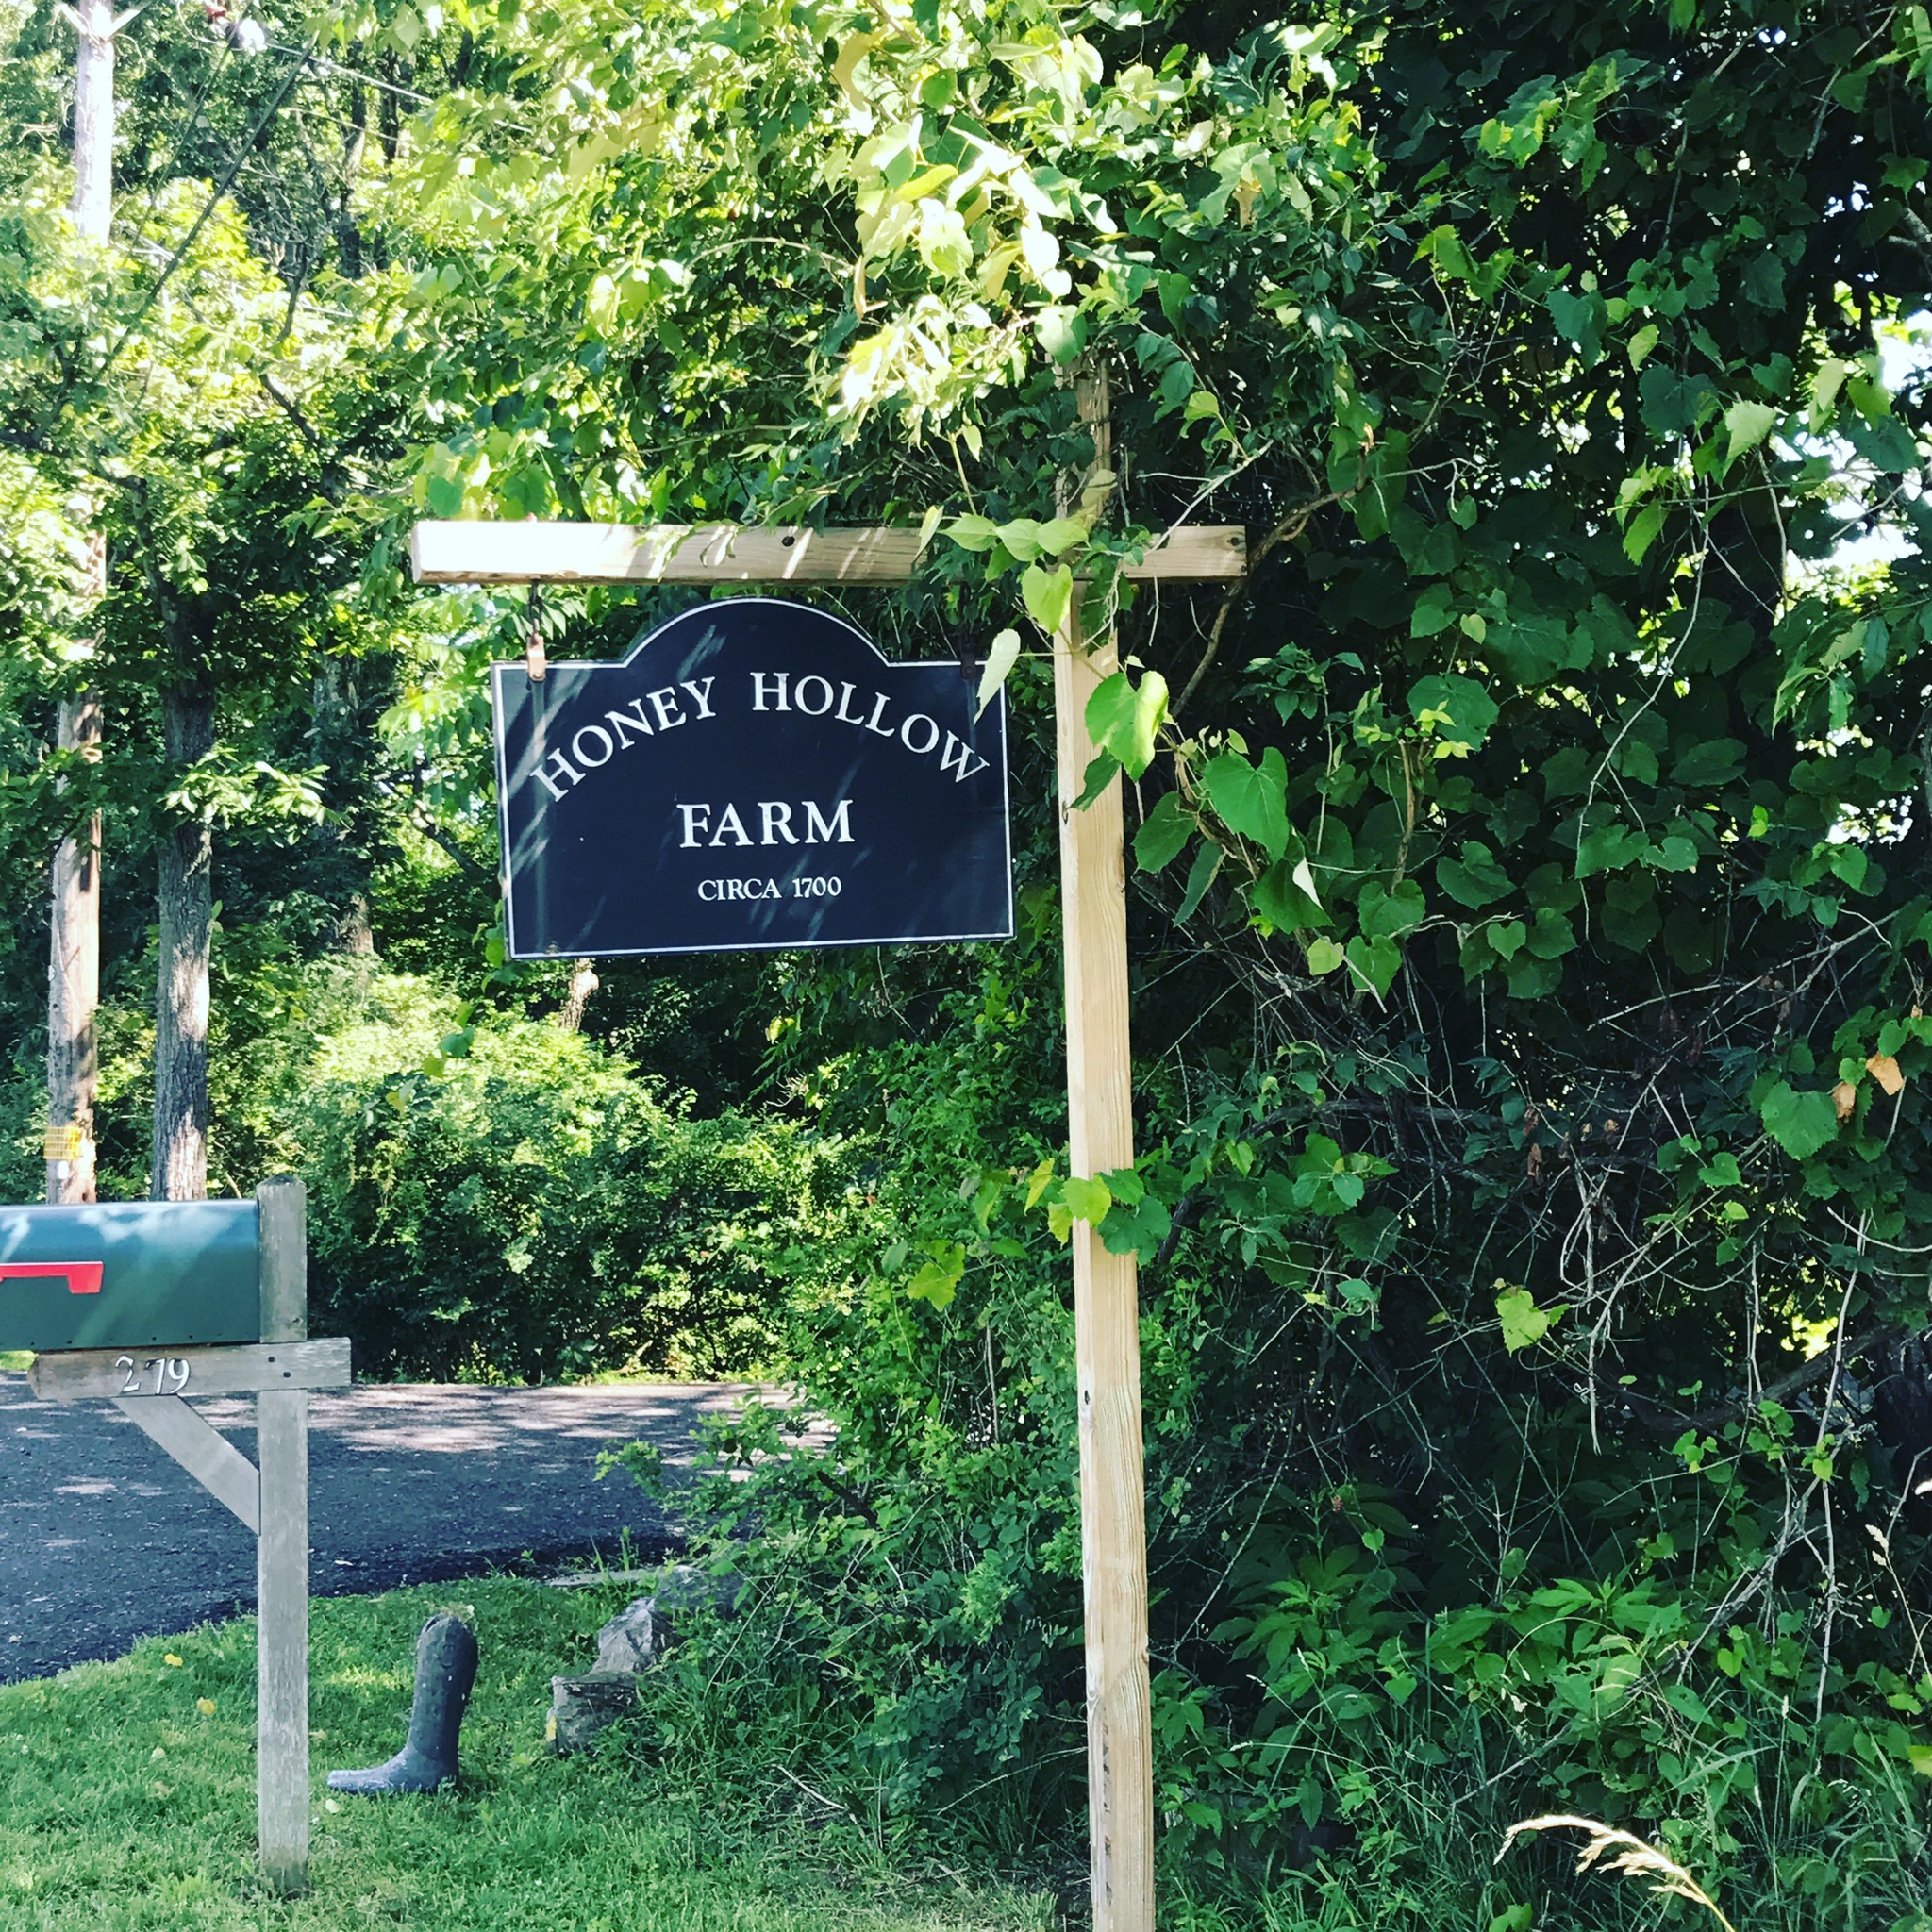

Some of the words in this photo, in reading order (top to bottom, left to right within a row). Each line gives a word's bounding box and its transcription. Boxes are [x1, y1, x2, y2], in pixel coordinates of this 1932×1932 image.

[529, 676, 717, 802] HONEY
[750, 671, 990, 784] HOLLOW
[676, 799, 855, 848] FARM
[697, 878, 782, 901] CIRCA
[793, 876, 842, 898] 1700
[114, 1355, 190, 1395] 279
